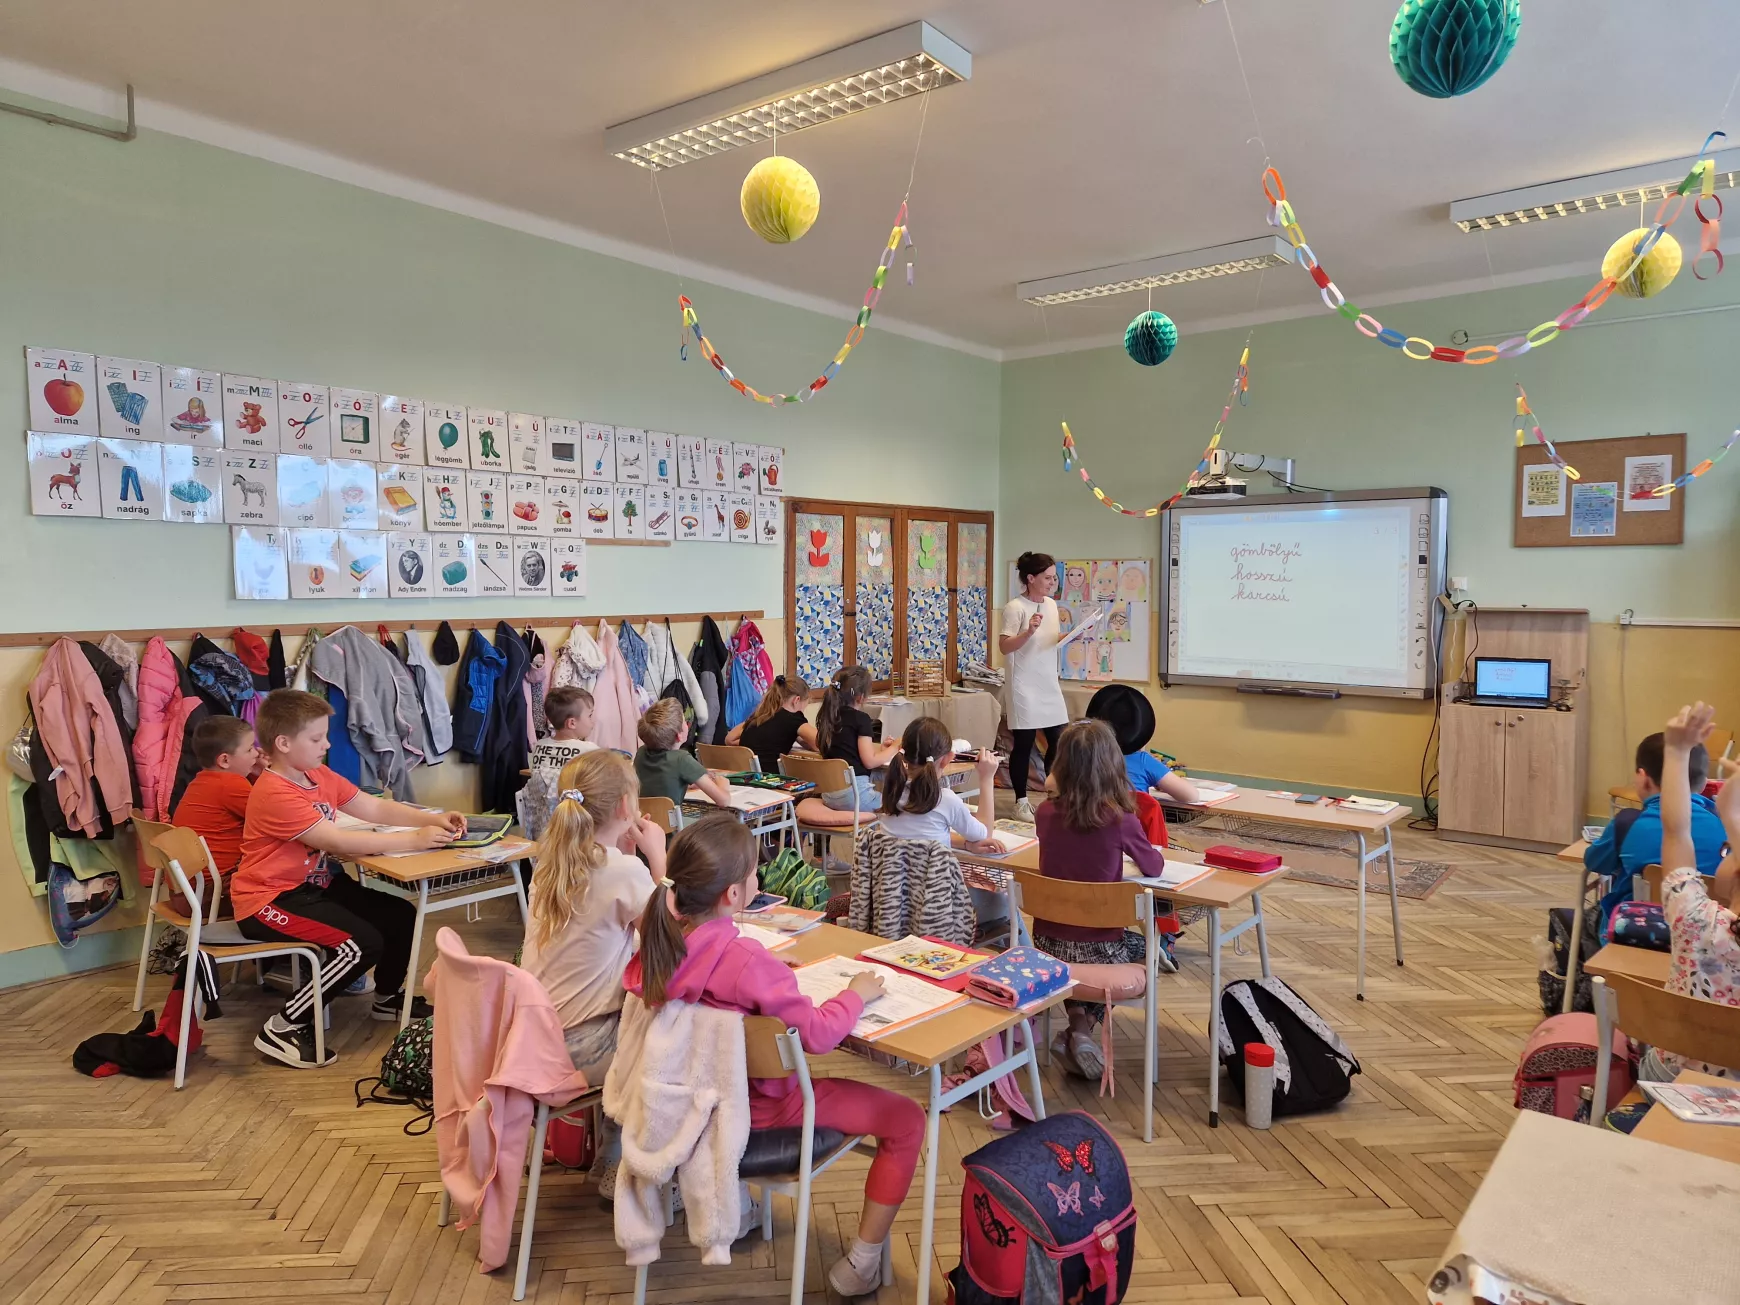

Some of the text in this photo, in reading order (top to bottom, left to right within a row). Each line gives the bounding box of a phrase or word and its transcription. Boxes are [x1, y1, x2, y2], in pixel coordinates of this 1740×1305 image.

[57, 359, 68, 371] A
[249, 386, 260, 397] M
[303, 392, 312, 402] O
[353, 398, 362, 411] Ó
[401, 404, 408, 414] E
[446, 410, 451, 419] L
[54, 416, 79, 425] alma
[488, 417, 494, 426] U
[125, 426, 140, 436] ing
[563, 426, 568, 434] T
[629, 435, 635, 443] R
[298, 443, 313, 451] olló
[192, 456, 200, 467] S
[248, 458, 256, 469] Z
[399, 472, 406, 480] K
[442, 475, 450, 484] H
[489, 478, 493, 486] J
[526, 482, 532, 490] P
[561, 485, 567, 494] G
[597, 487, 602, 495] D
[629, 488, 634, 496] F
[117, 505, 150, 515] nadrág
[240, 510, 263, 519] zebra
[478, 542, 509, 550] dzs Dzs
[530, 542, 538, 550] W
[1230, 542, 1302, 565] gömbölyű
[1231, 562, 1293, 582] hosszú
[309, 586, 325, 594] lyuk
[1231, 582, 1290, 602] karcsú
[534, 745, 580, 757] THE TOP
[532, 755, 546, 765] OF
